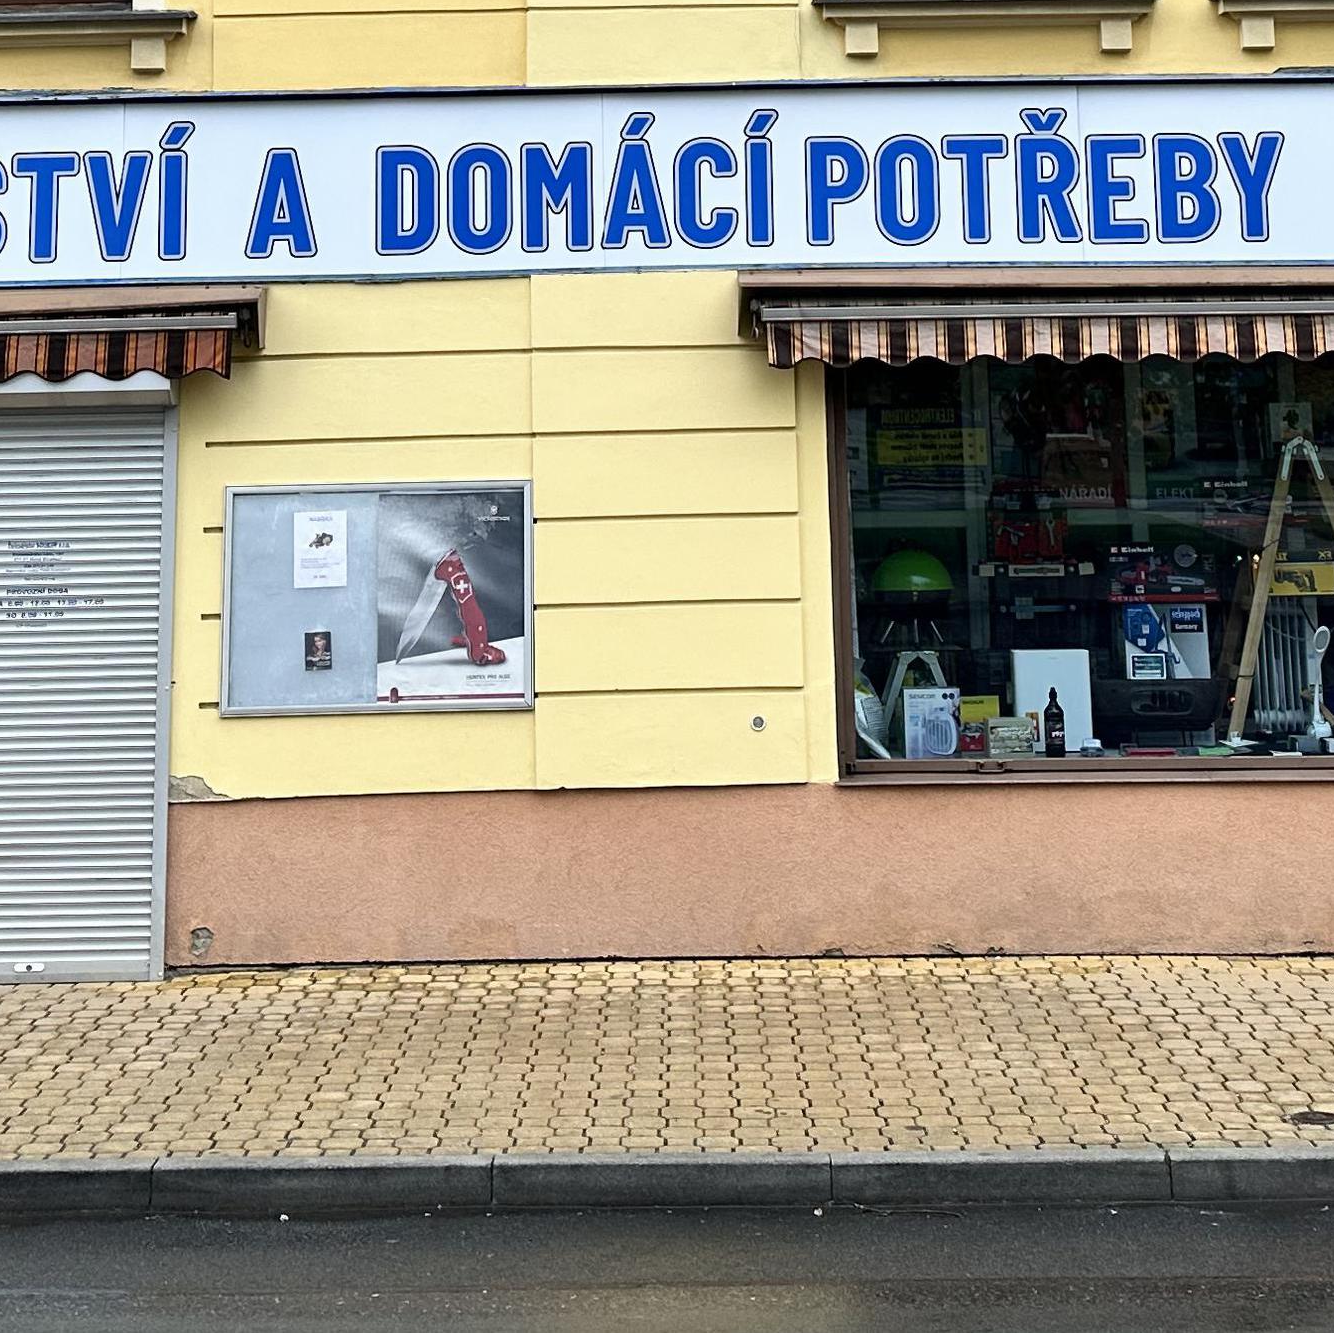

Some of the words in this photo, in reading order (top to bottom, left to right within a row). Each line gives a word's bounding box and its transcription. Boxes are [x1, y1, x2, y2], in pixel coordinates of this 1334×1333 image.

[245, 147, 318, 259] A
[376, 109, 779, 256] DOMÁCÍ
[805, 107, 1285, 247] POTŘEBY
